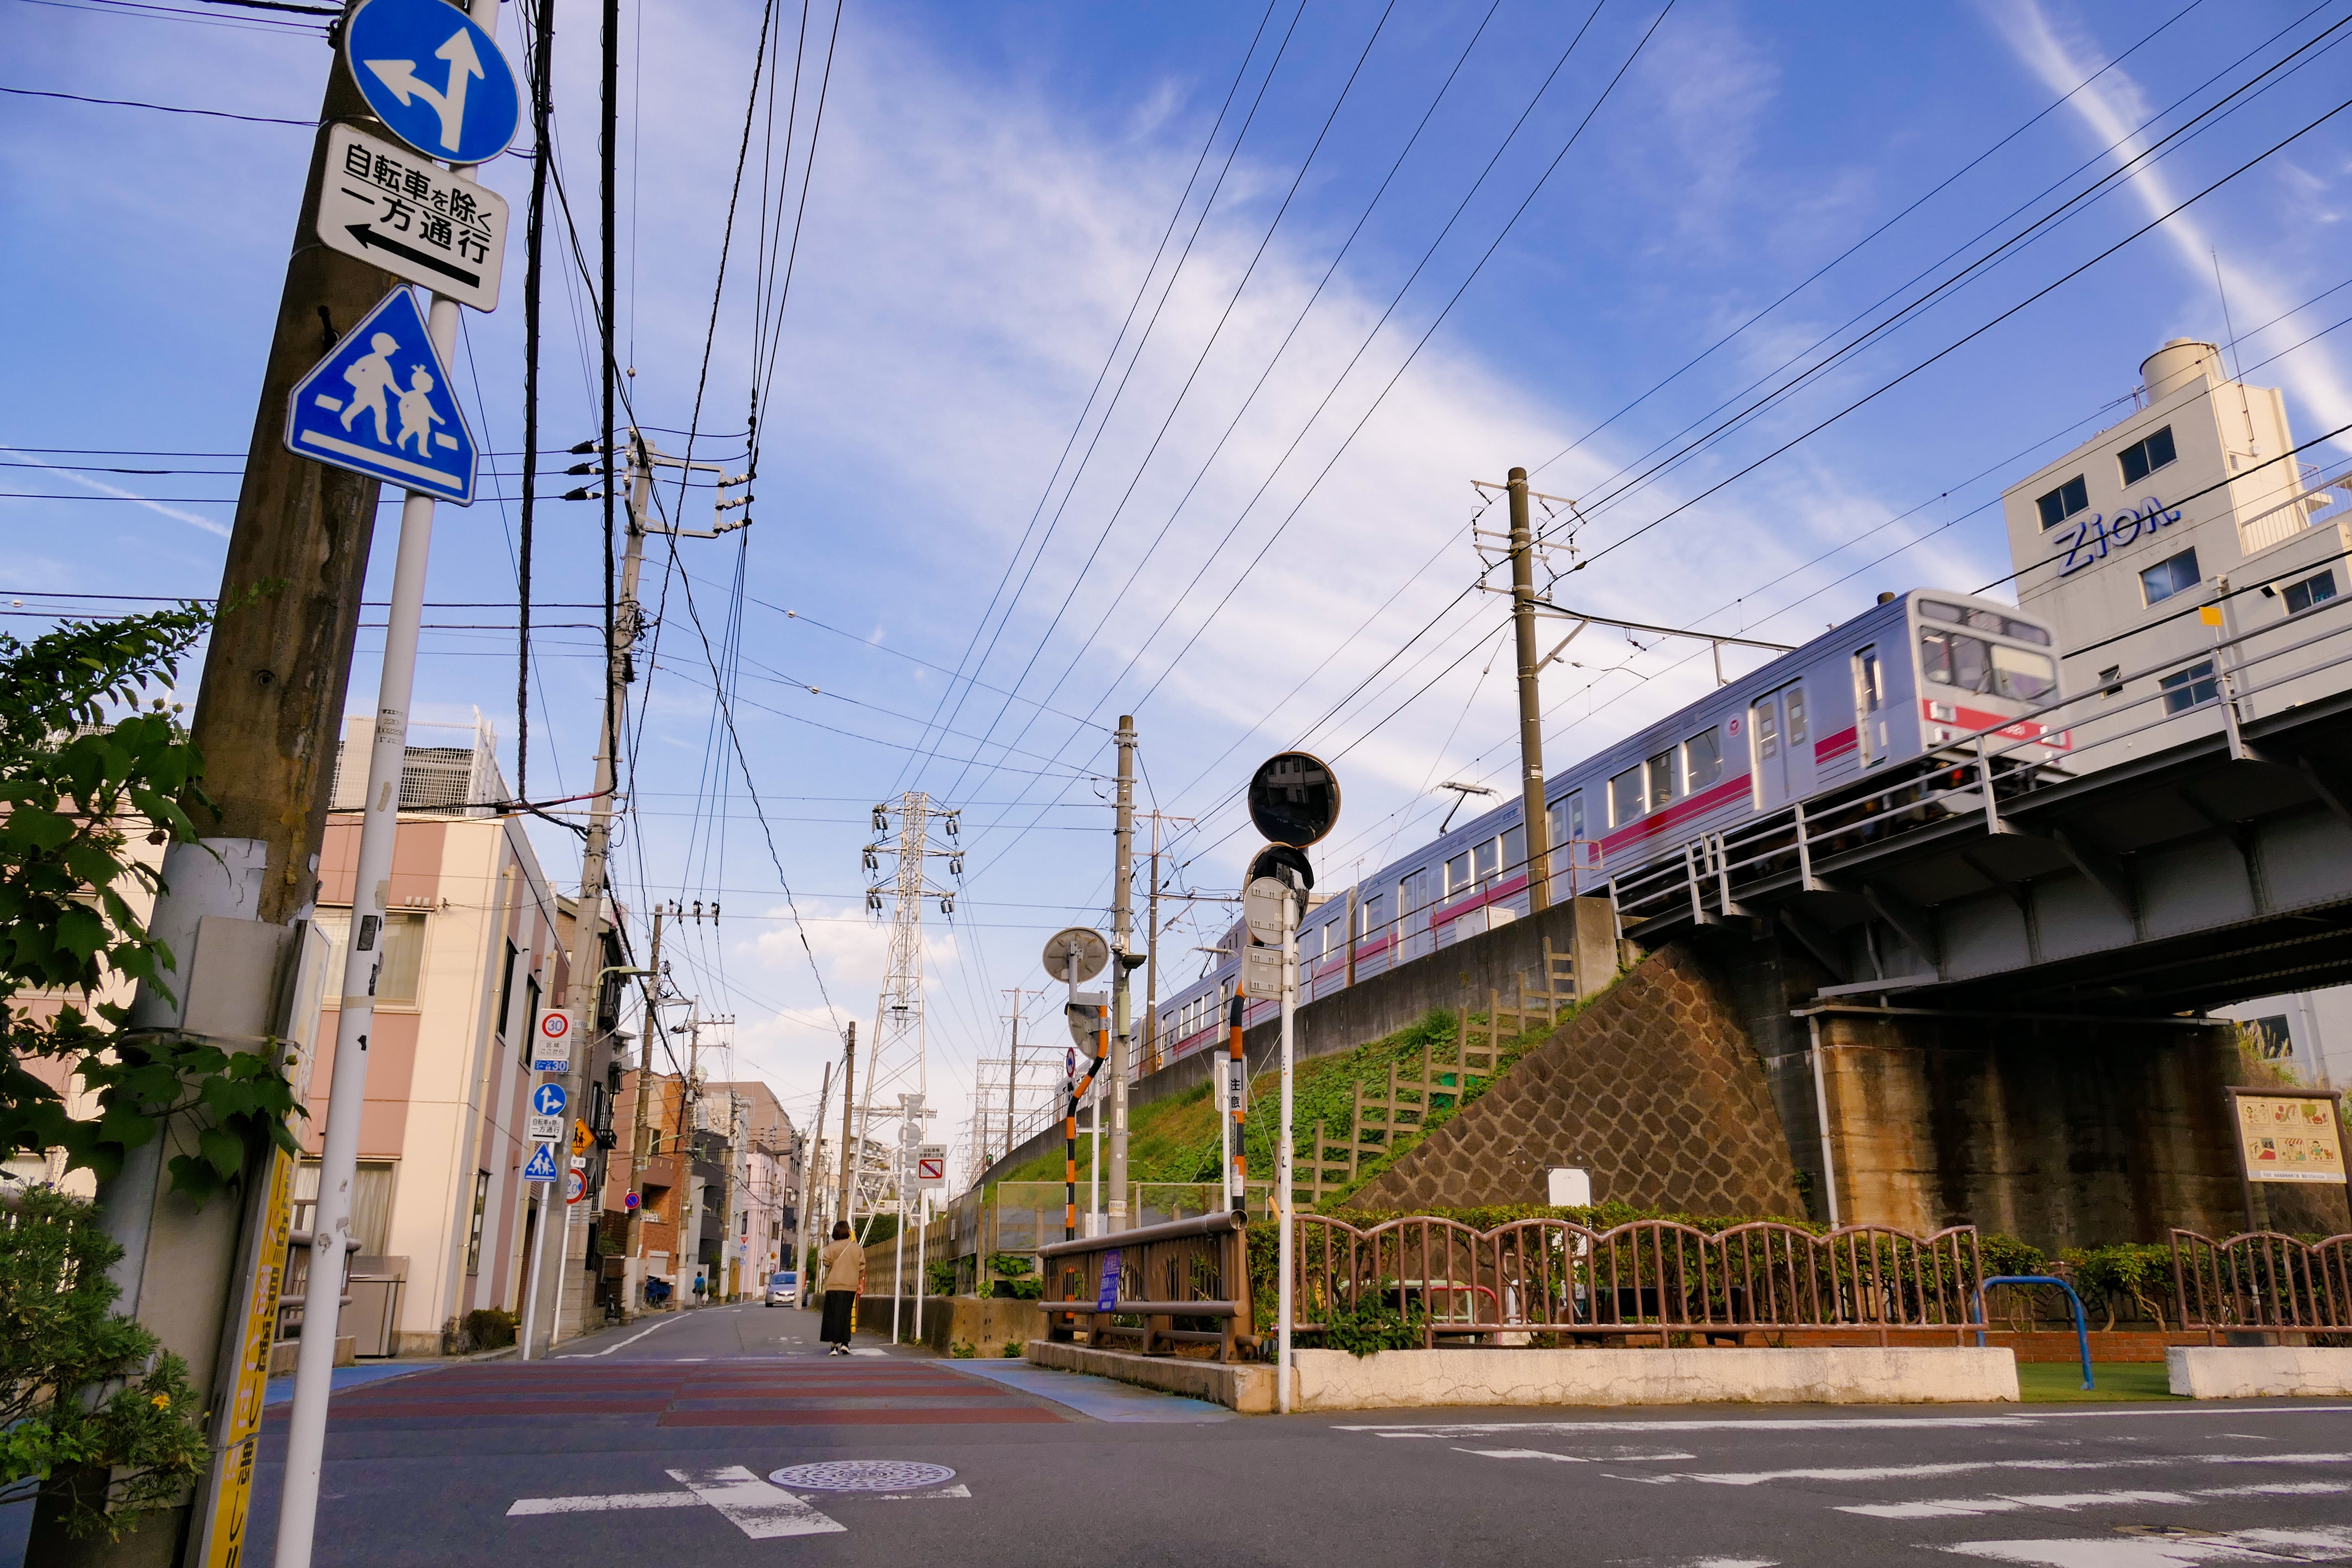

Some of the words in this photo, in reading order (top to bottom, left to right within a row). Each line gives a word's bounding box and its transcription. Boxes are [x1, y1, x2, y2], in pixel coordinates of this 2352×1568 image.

[346, 143, 492, 232] 自転車を除く
[341, 187, 490, 264] 一方通行
[548, 1020, 563, 1031] 30
[1231, 1078, 1241, 1108] 注意
